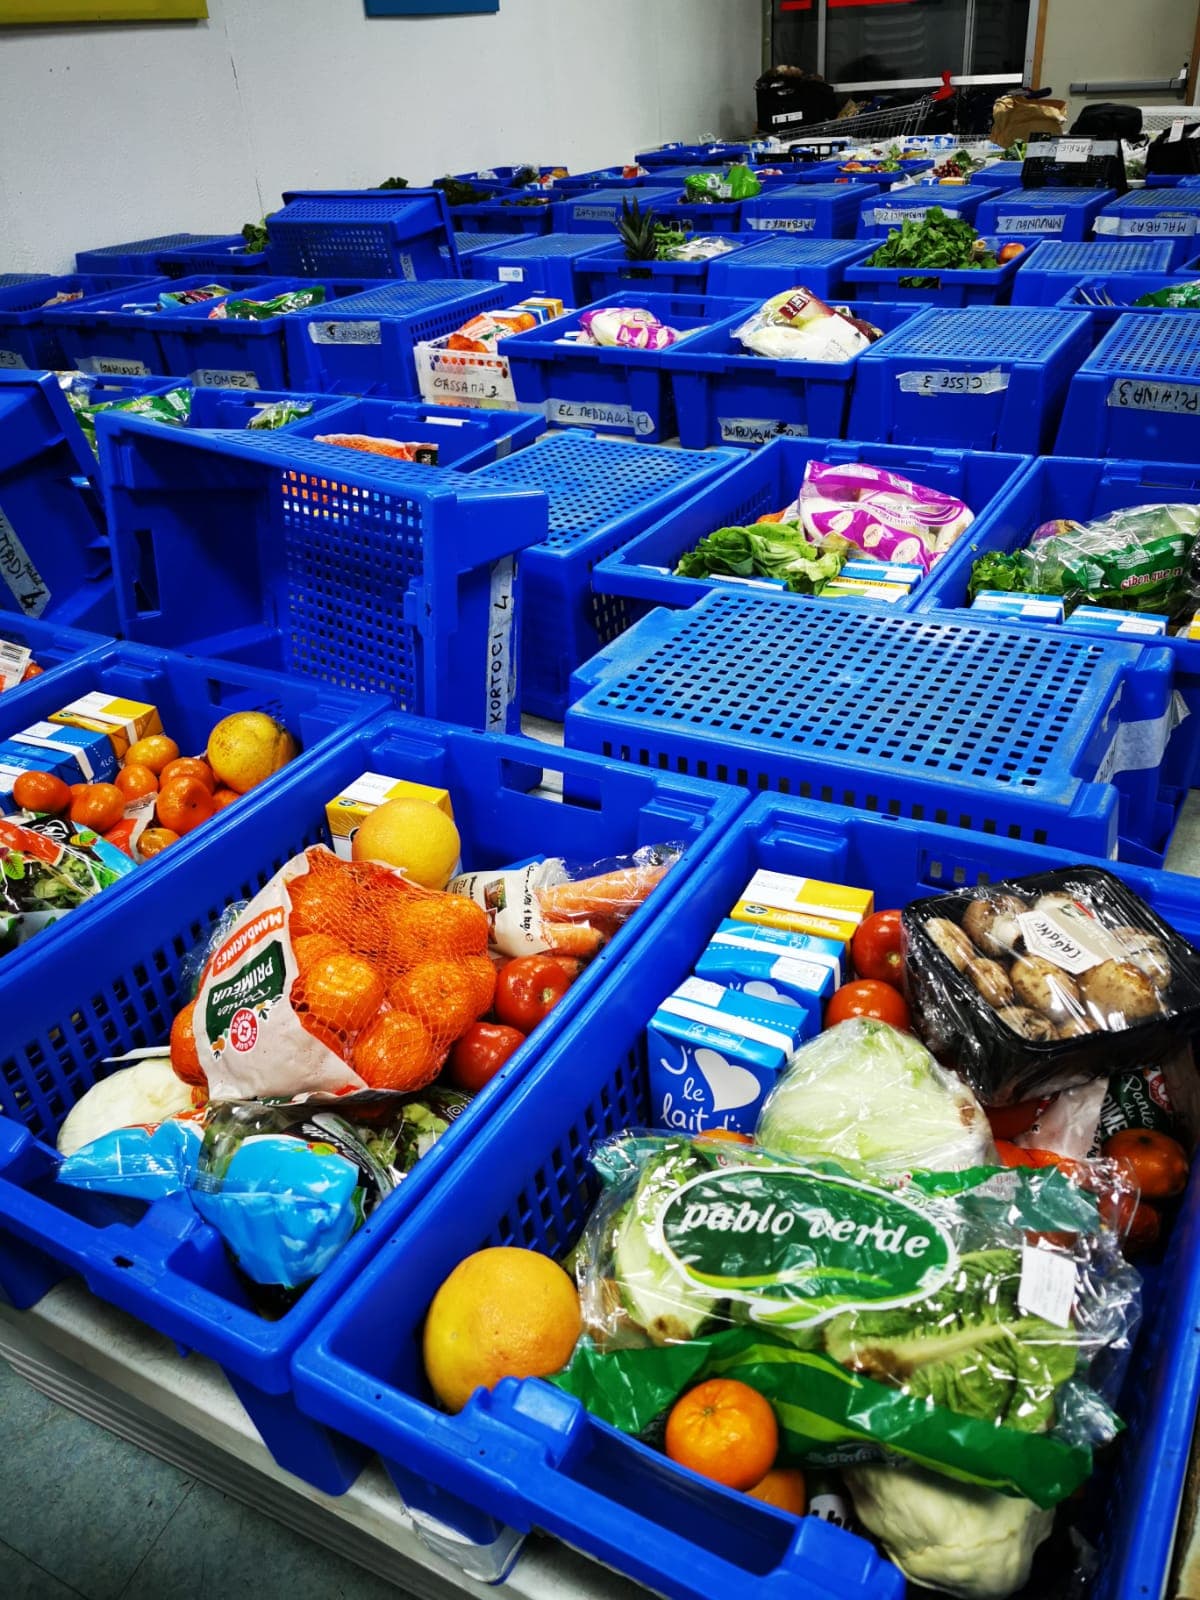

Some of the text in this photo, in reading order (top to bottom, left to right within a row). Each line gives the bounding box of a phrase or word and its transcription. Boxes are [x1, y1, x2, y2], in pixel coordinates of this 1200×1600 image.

[203, 372, 249, 387] GOMEZ
[923, 375, 934, 388] 3
[1119, 381, 1133, 405] 3
[558, 404, 575, 416] EL
[494, 595, 509, 610] 4
[216, 911, 283, 969] MANDARINES
[212, 956, 274, 1005] PRIMEUR
[660, 1045, 692, 1075] J'
[682, 1077, 705, 1101] le
[1123, 1075, 1155, 1129] Panie
[660, 1092, 709, 1133] lait
[678, 1201, 931, 1258] pablo verde
